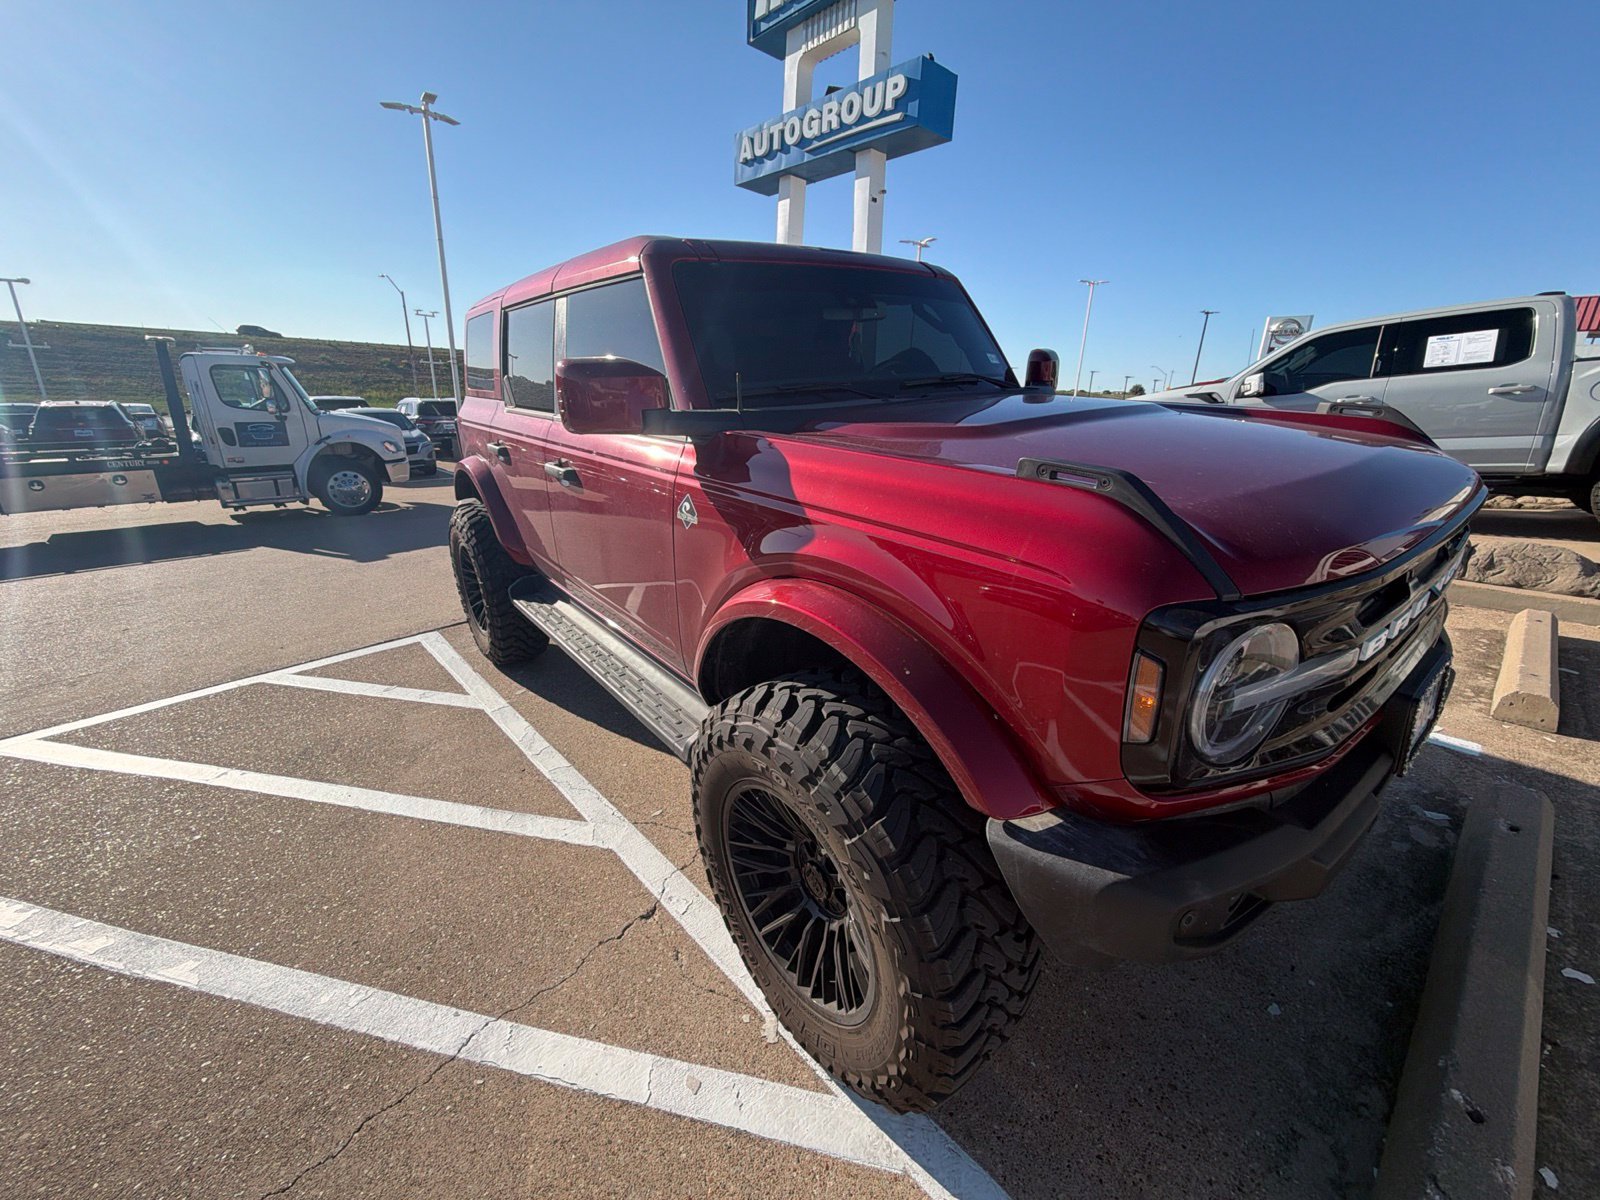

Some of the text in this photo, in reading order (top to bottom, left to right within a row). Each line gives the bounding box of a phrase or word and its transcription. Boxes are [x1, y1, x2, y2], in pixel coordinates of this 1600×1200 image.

[739, 74, 908, 163] AUTOGROUP
[107, 459, 145, 468] CENTURY
[751, 755, 829, 835] TOYO
[708, 851, 836, 1058] OPEN COUNTRY
